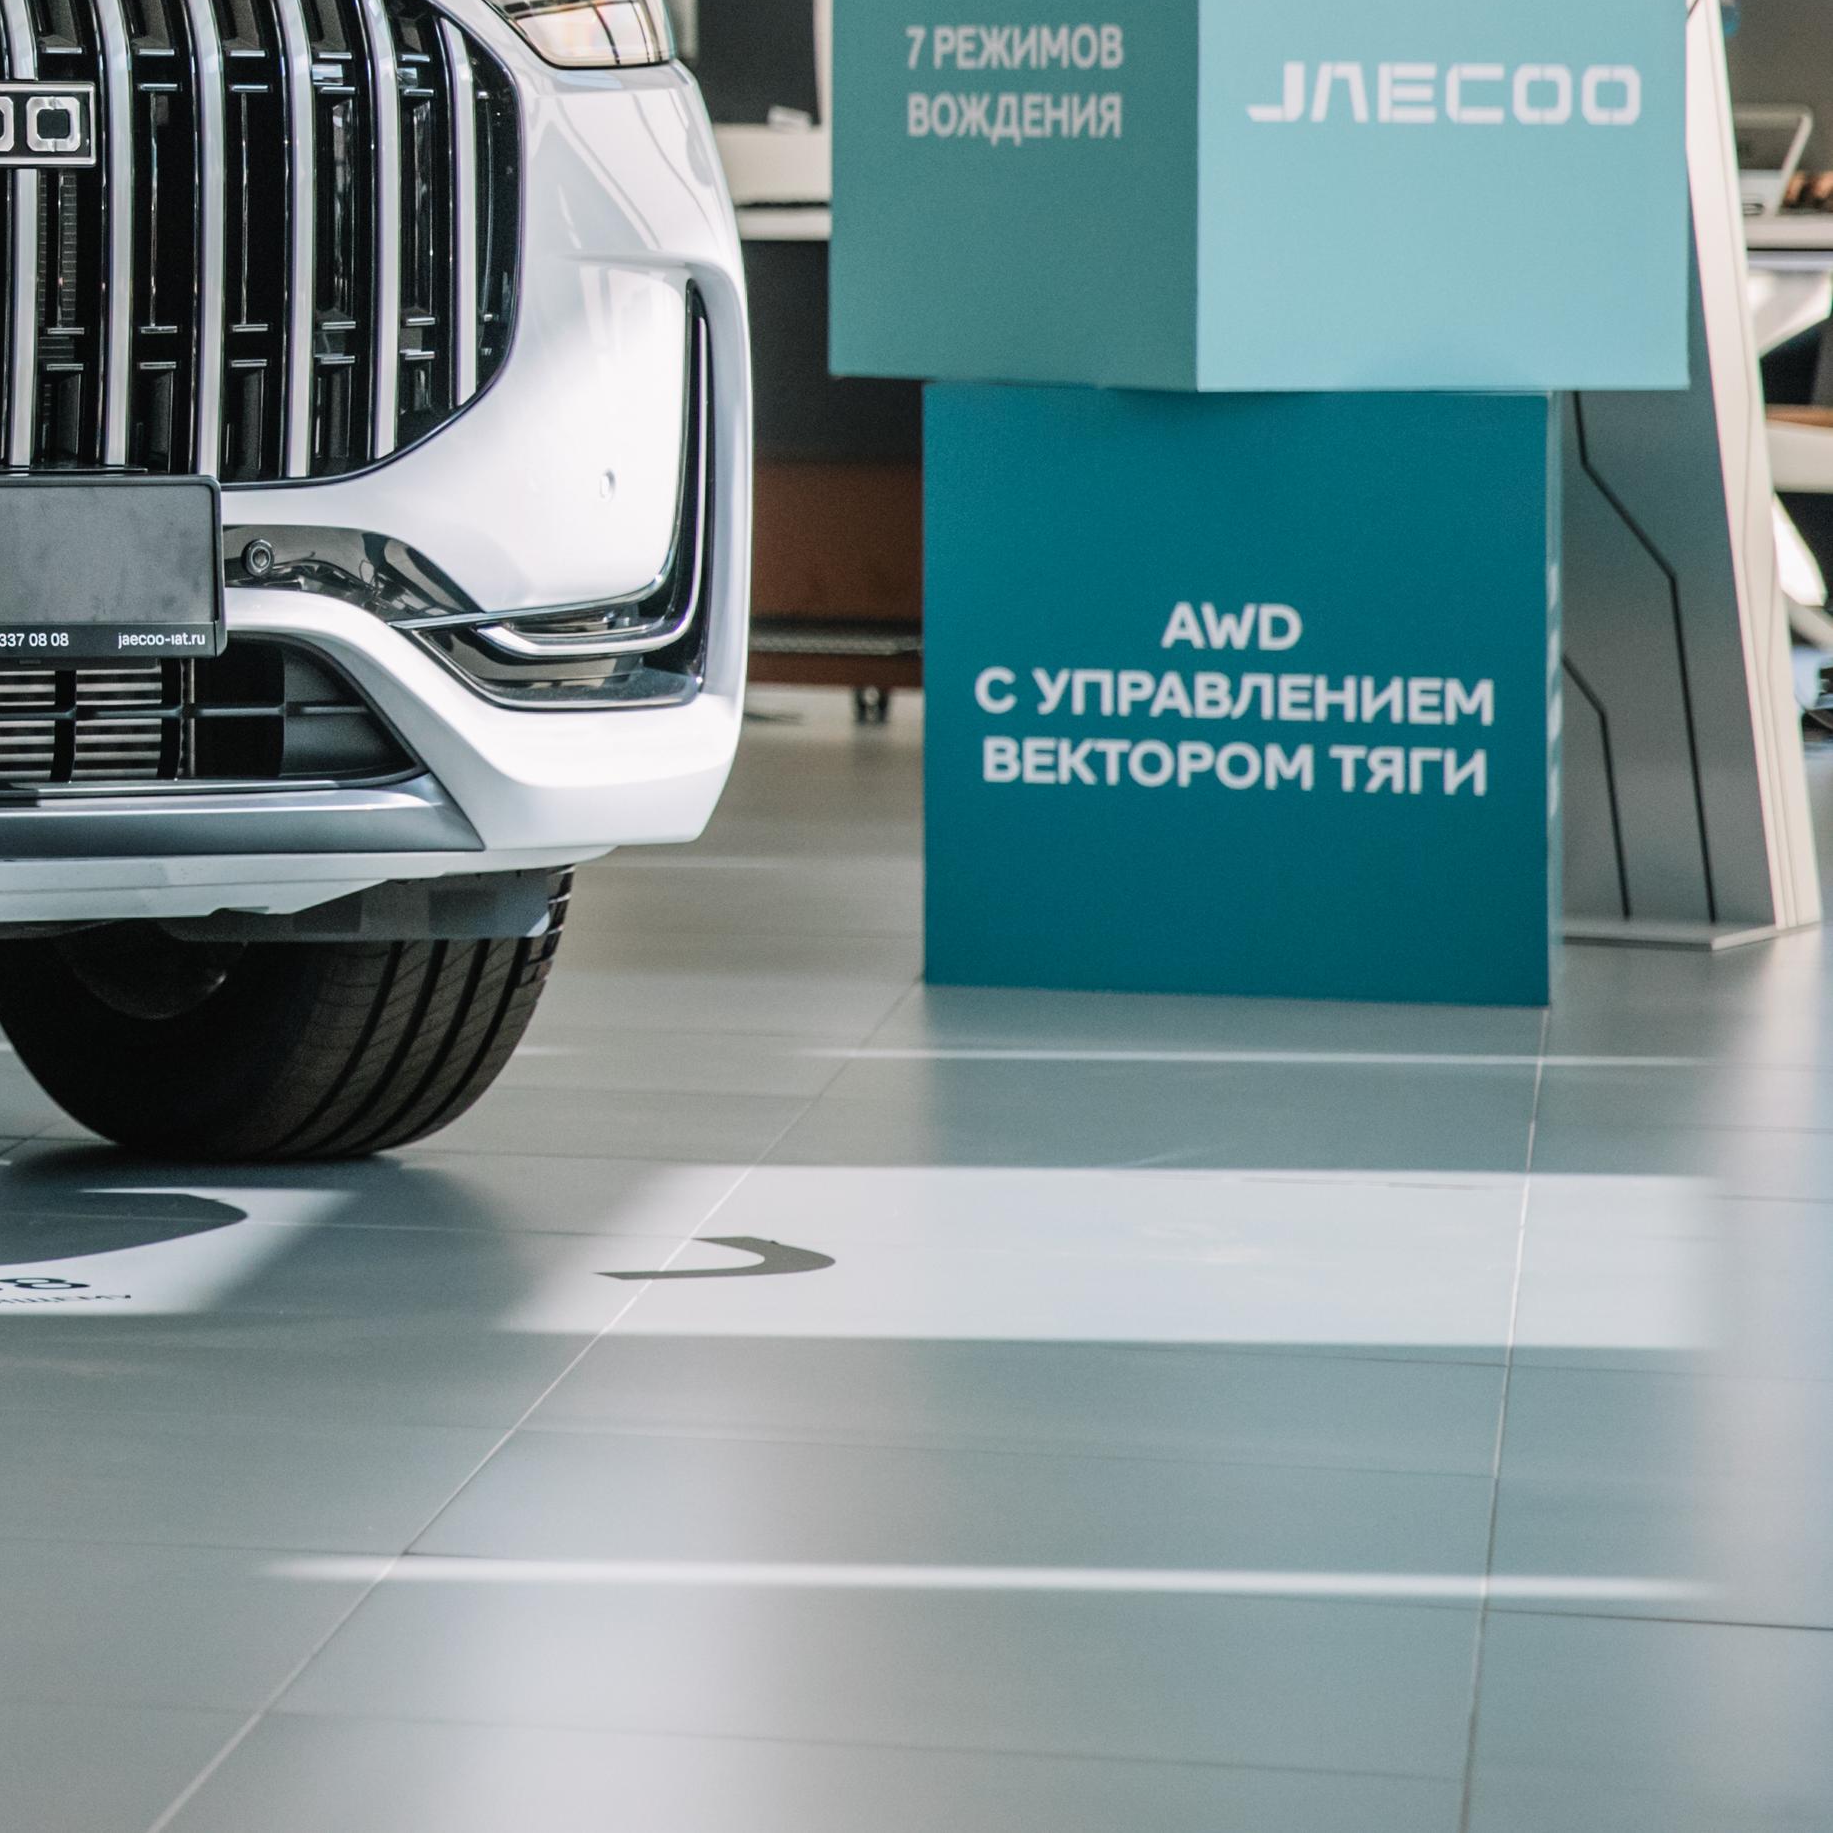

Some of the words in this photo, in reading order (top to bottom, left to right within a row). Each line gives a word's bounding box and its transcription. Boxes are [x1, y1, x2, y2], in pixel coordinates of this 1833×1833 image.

[905, 25, 927, 70] 7
[933, 24, 1124, 70] РЕЖИМОВ
[1246, 60, 1641, 125] JAECOO
[907, 92, 1122, 147] ВОЖДЕНИЯ
[28, 632, 48, 647] 08
[50, 632, 70, 647] 08
[118, 632, 206, 650] jaecoo-iat.ru
[1161, 601, 1303, 651] AWD
[974, 666, 1017, 714] С
[1032, 667, 1495, 726] УПРАВЛЕНИЕМ
[983, 735, 1315, 791] ВЕКТОРОМ
[1328, 744, 1487, 797] ТЯГИ
